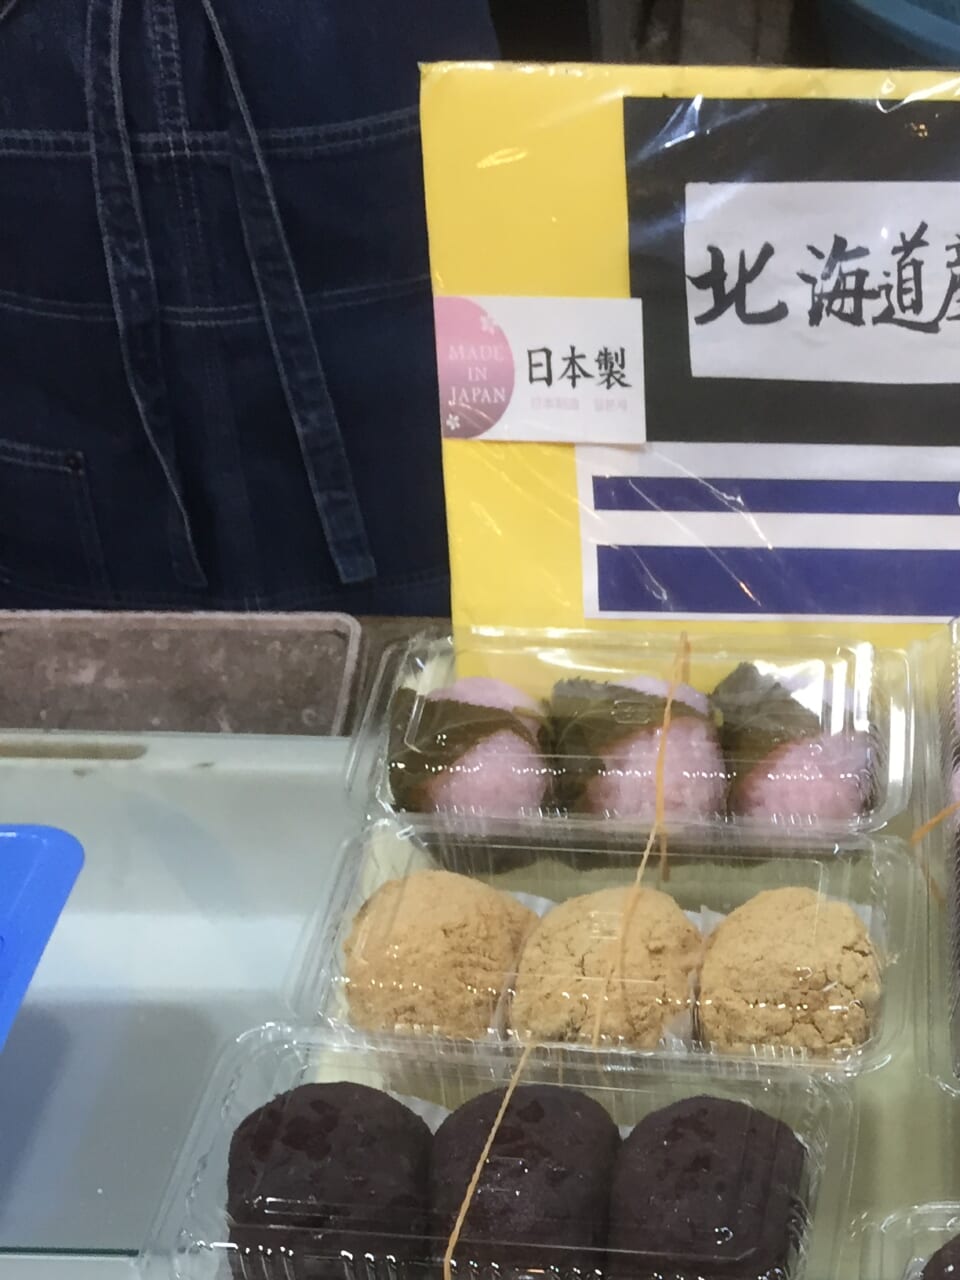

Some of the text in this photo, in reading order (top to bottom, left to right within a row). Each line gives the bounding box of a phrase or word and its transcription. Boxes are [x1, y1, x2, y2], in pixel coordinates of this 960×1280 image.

[449, 345, 505, 361] MADE
[468, 367, 488, 381] IN
[527, 345, 633, 390] 日本製
[450, 386, 506, 405] JAPAN
